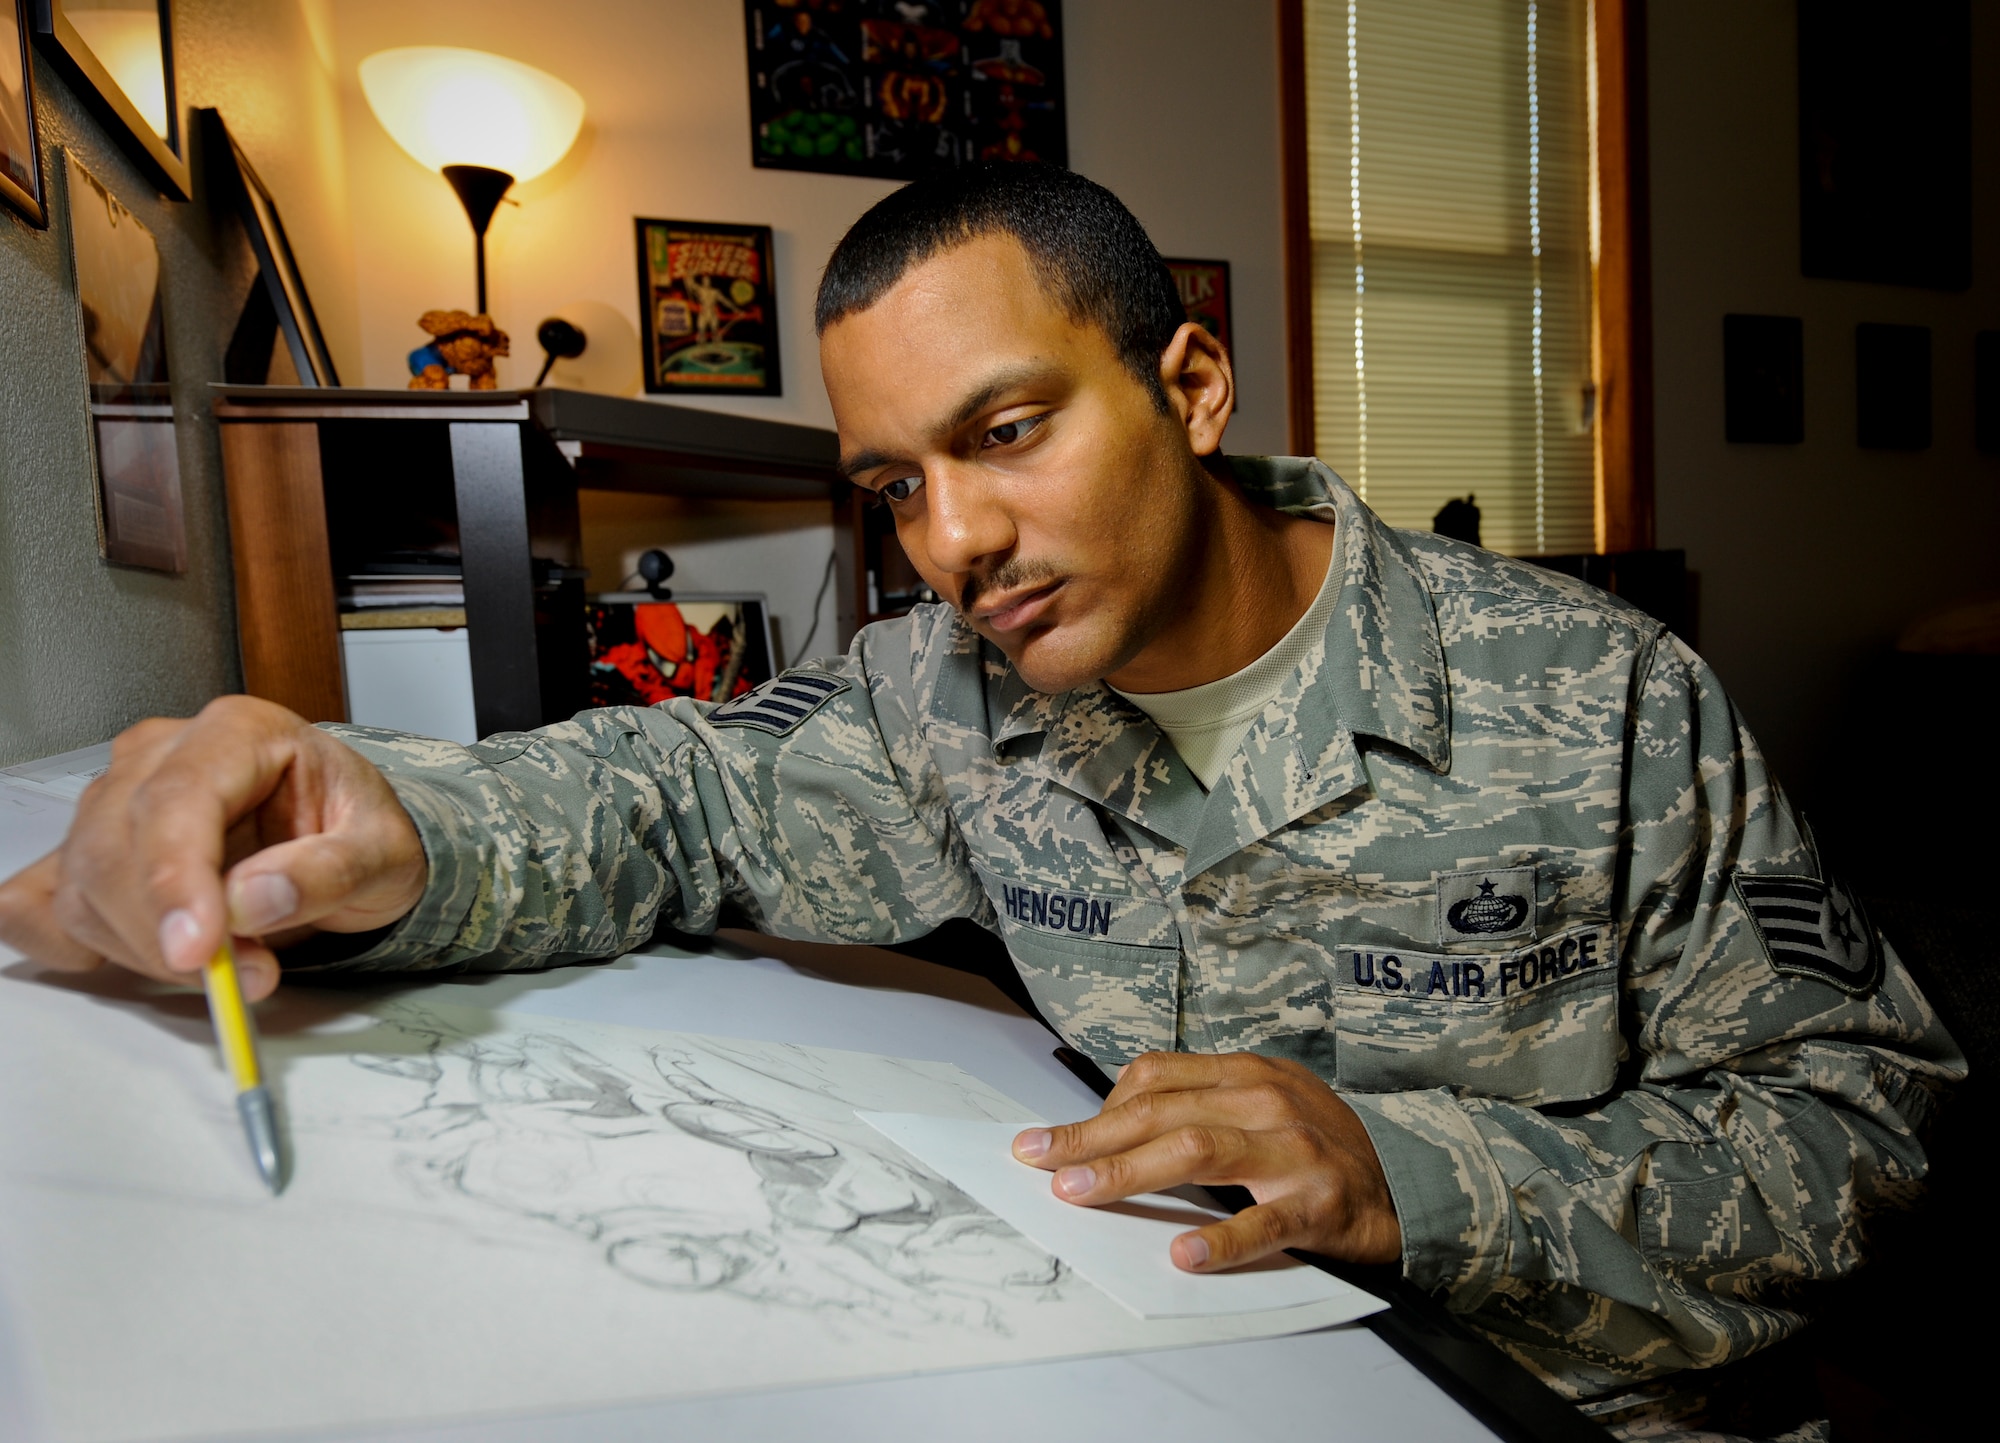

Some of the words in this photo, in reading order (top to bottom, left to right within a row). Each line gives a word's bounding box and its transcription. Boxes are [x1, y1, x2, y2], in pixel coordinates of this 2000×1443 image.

[672, 257, 755, 278] SURFER
[677, 242, 752, 262] SILVER
[1003, 884, 1112, 936] HENSON
[1353, 952, 1411, 993] U.S.
[1427, 961, 1486, 998] AIR
[1499, 933, 1598, 997] FORCE
